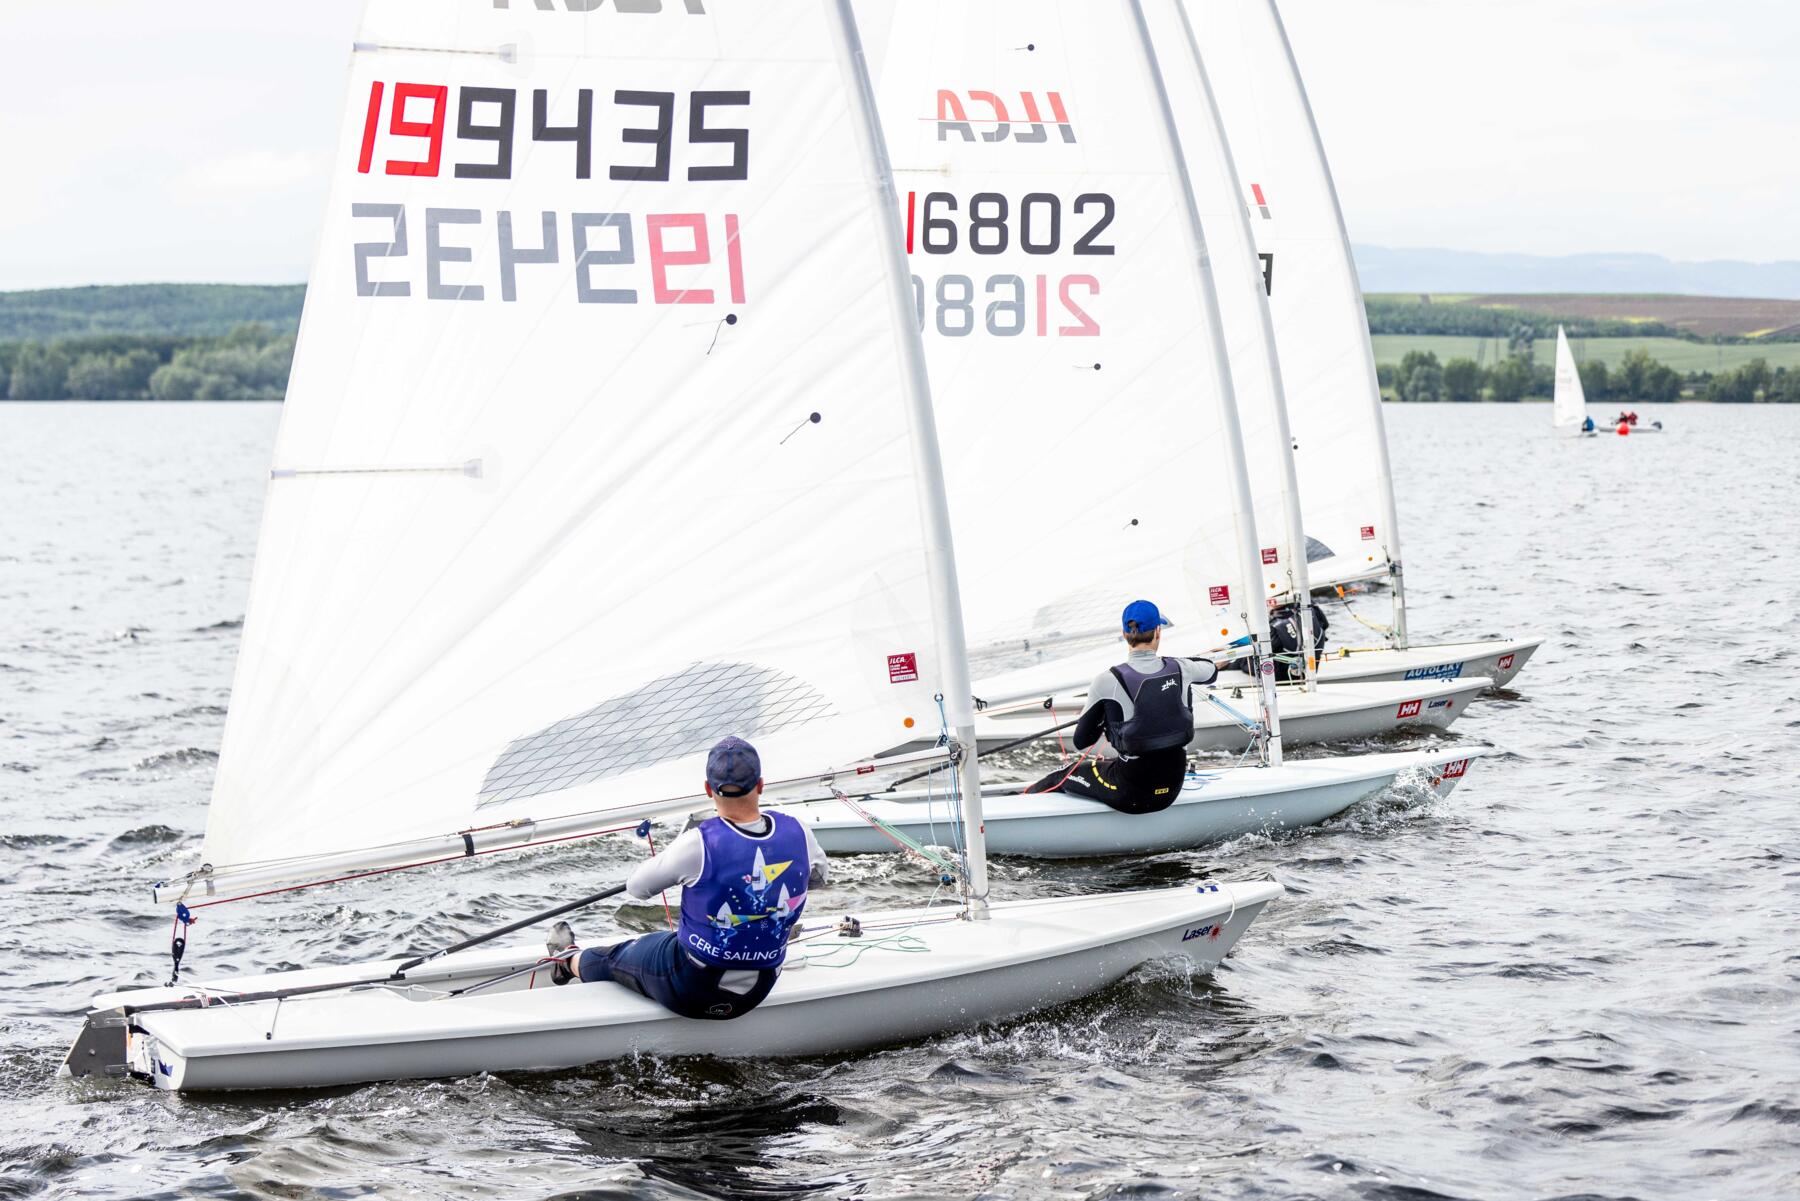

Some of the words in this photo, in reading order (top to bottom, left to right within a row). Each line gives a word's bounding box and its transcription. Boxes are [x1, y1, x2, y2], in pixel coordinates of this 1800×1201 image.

[357, 80, 751, 182] 199435
[1161, 678, 1177, 691] zhik
[1399, 701, 1420, 716] HH
[1181, 924, 1213, 942] Laser
[688, 933, 720, 957] CERE
[723, 949, 778, 961] SAILING
